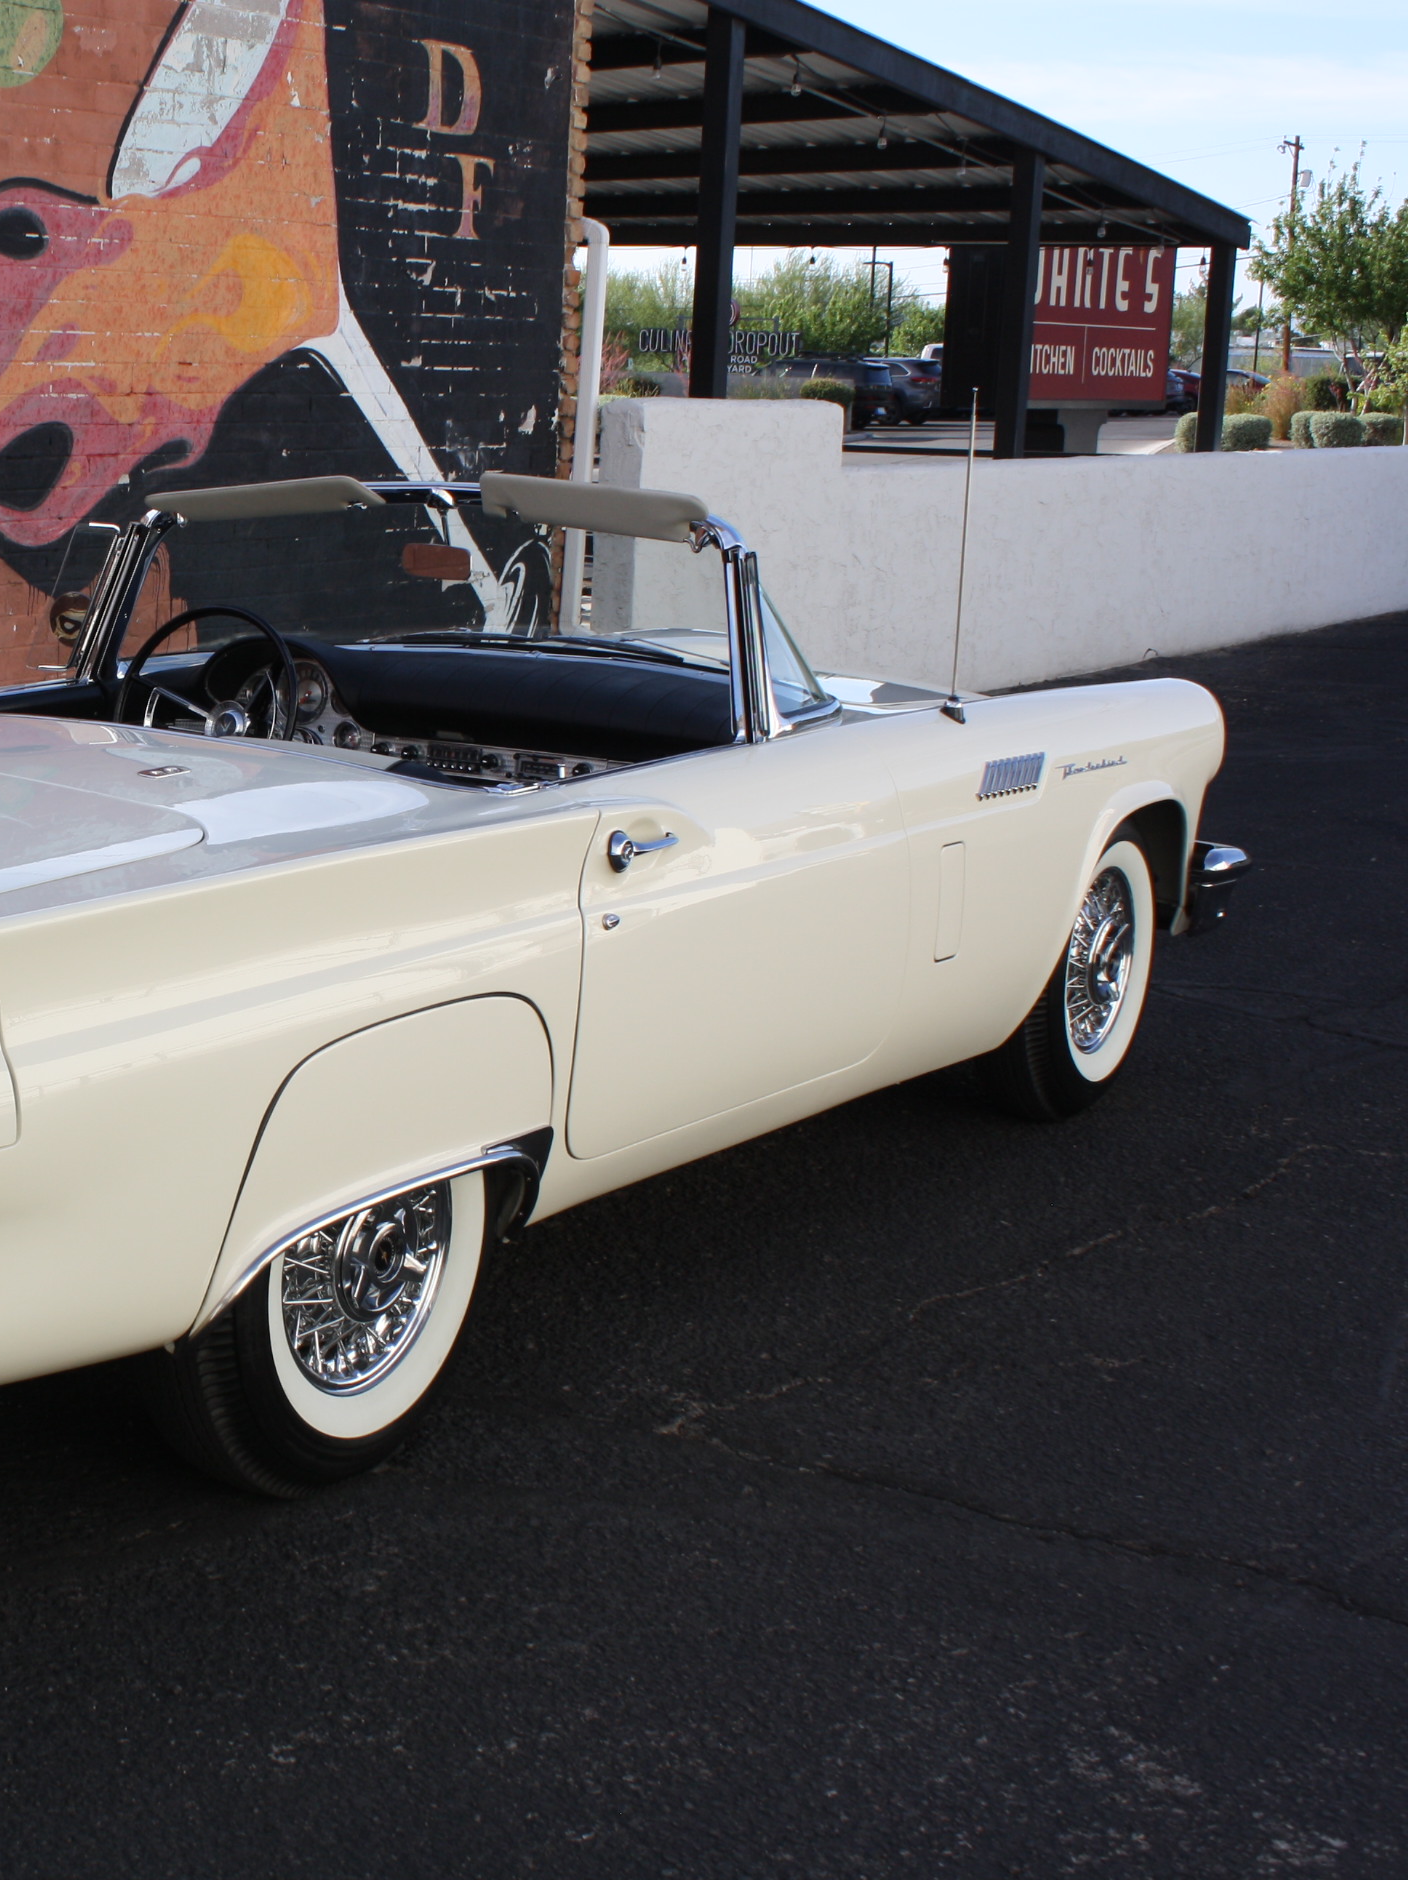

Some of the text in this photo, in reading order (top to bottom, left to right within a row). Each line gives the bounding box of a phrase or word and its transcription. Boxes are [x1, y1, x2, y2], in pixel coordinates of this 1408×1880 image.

[413, 39, 482, 136] D
[454, 153, 495, 240] F
[639, 329, 693, 353] CULINA
[730, 355, 758, 364] ROAD
[1030, 344, 1154, 378] ITCHEN COCKTAILS
